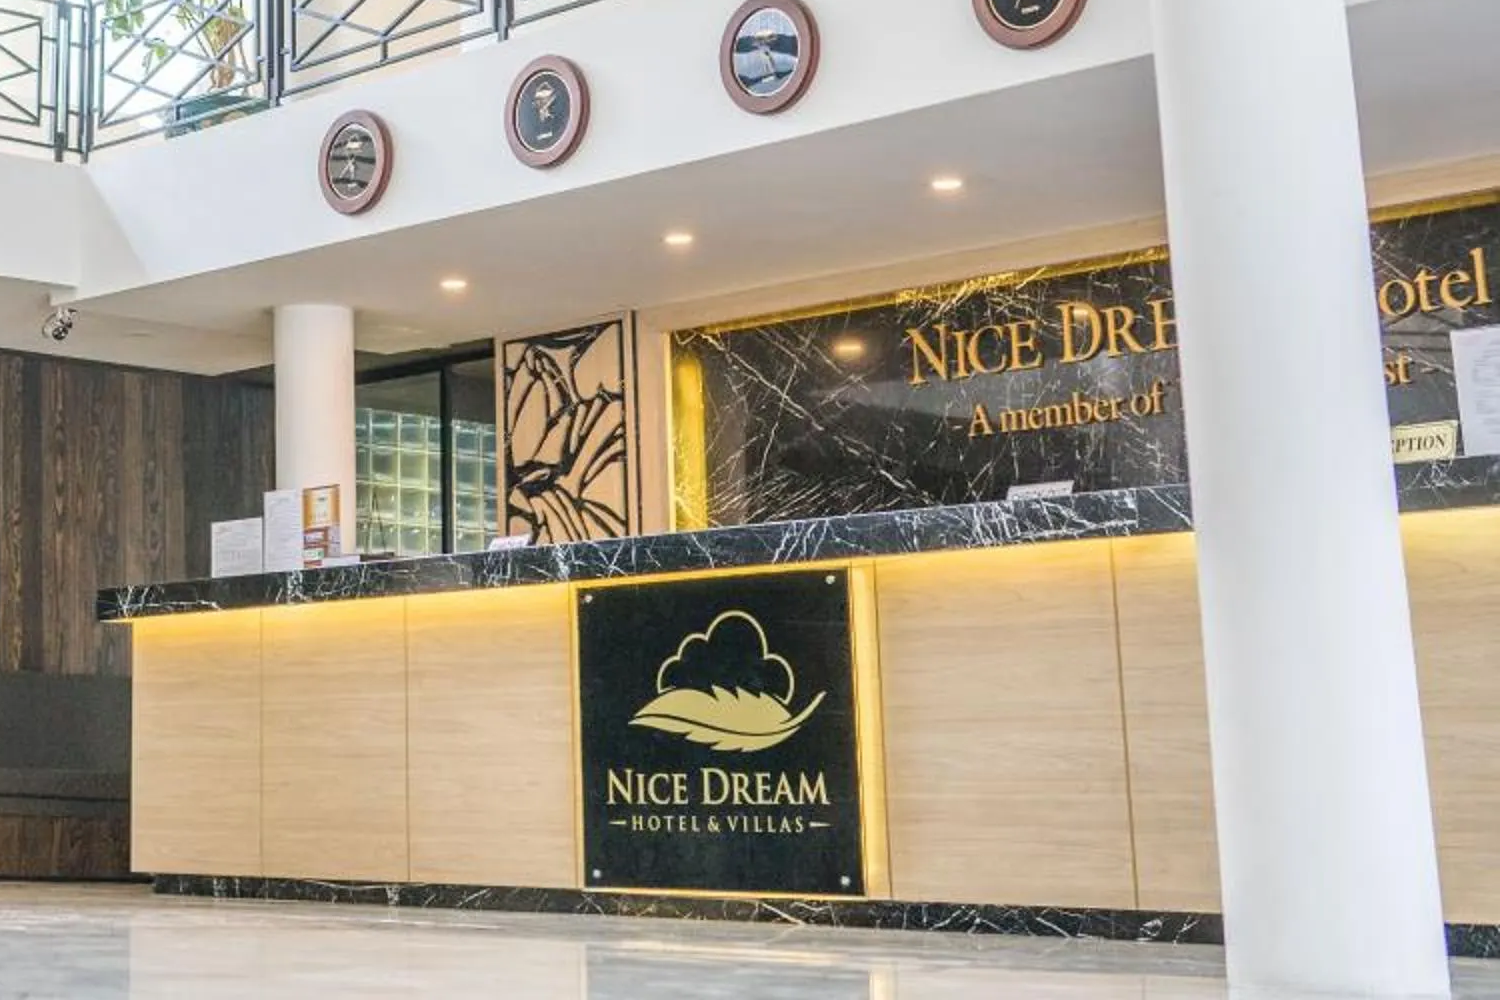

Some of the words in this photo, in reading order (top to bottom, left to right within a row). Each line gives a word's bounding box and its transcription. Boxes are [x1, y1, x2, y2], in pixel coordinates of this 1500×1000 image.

[905, 318, 1043, 386] NICE
[1056, 298, 1179, 363] DRE
[1378, 246, 1494, 318] otel
[968, 402, 994, 438] A
[1000, 390, 1124, 434] member
[1130, 376, 1166, 417] of
[1391, 433, 1448, 454] PTION
[605, 767, 689, 806] NICE
[700, 766, 831, 806] DREAM
[631, 814, 701, 832] HOTEL
[707, 815, 722, 833] &
[725, 814, 805, 834] VILLAS
